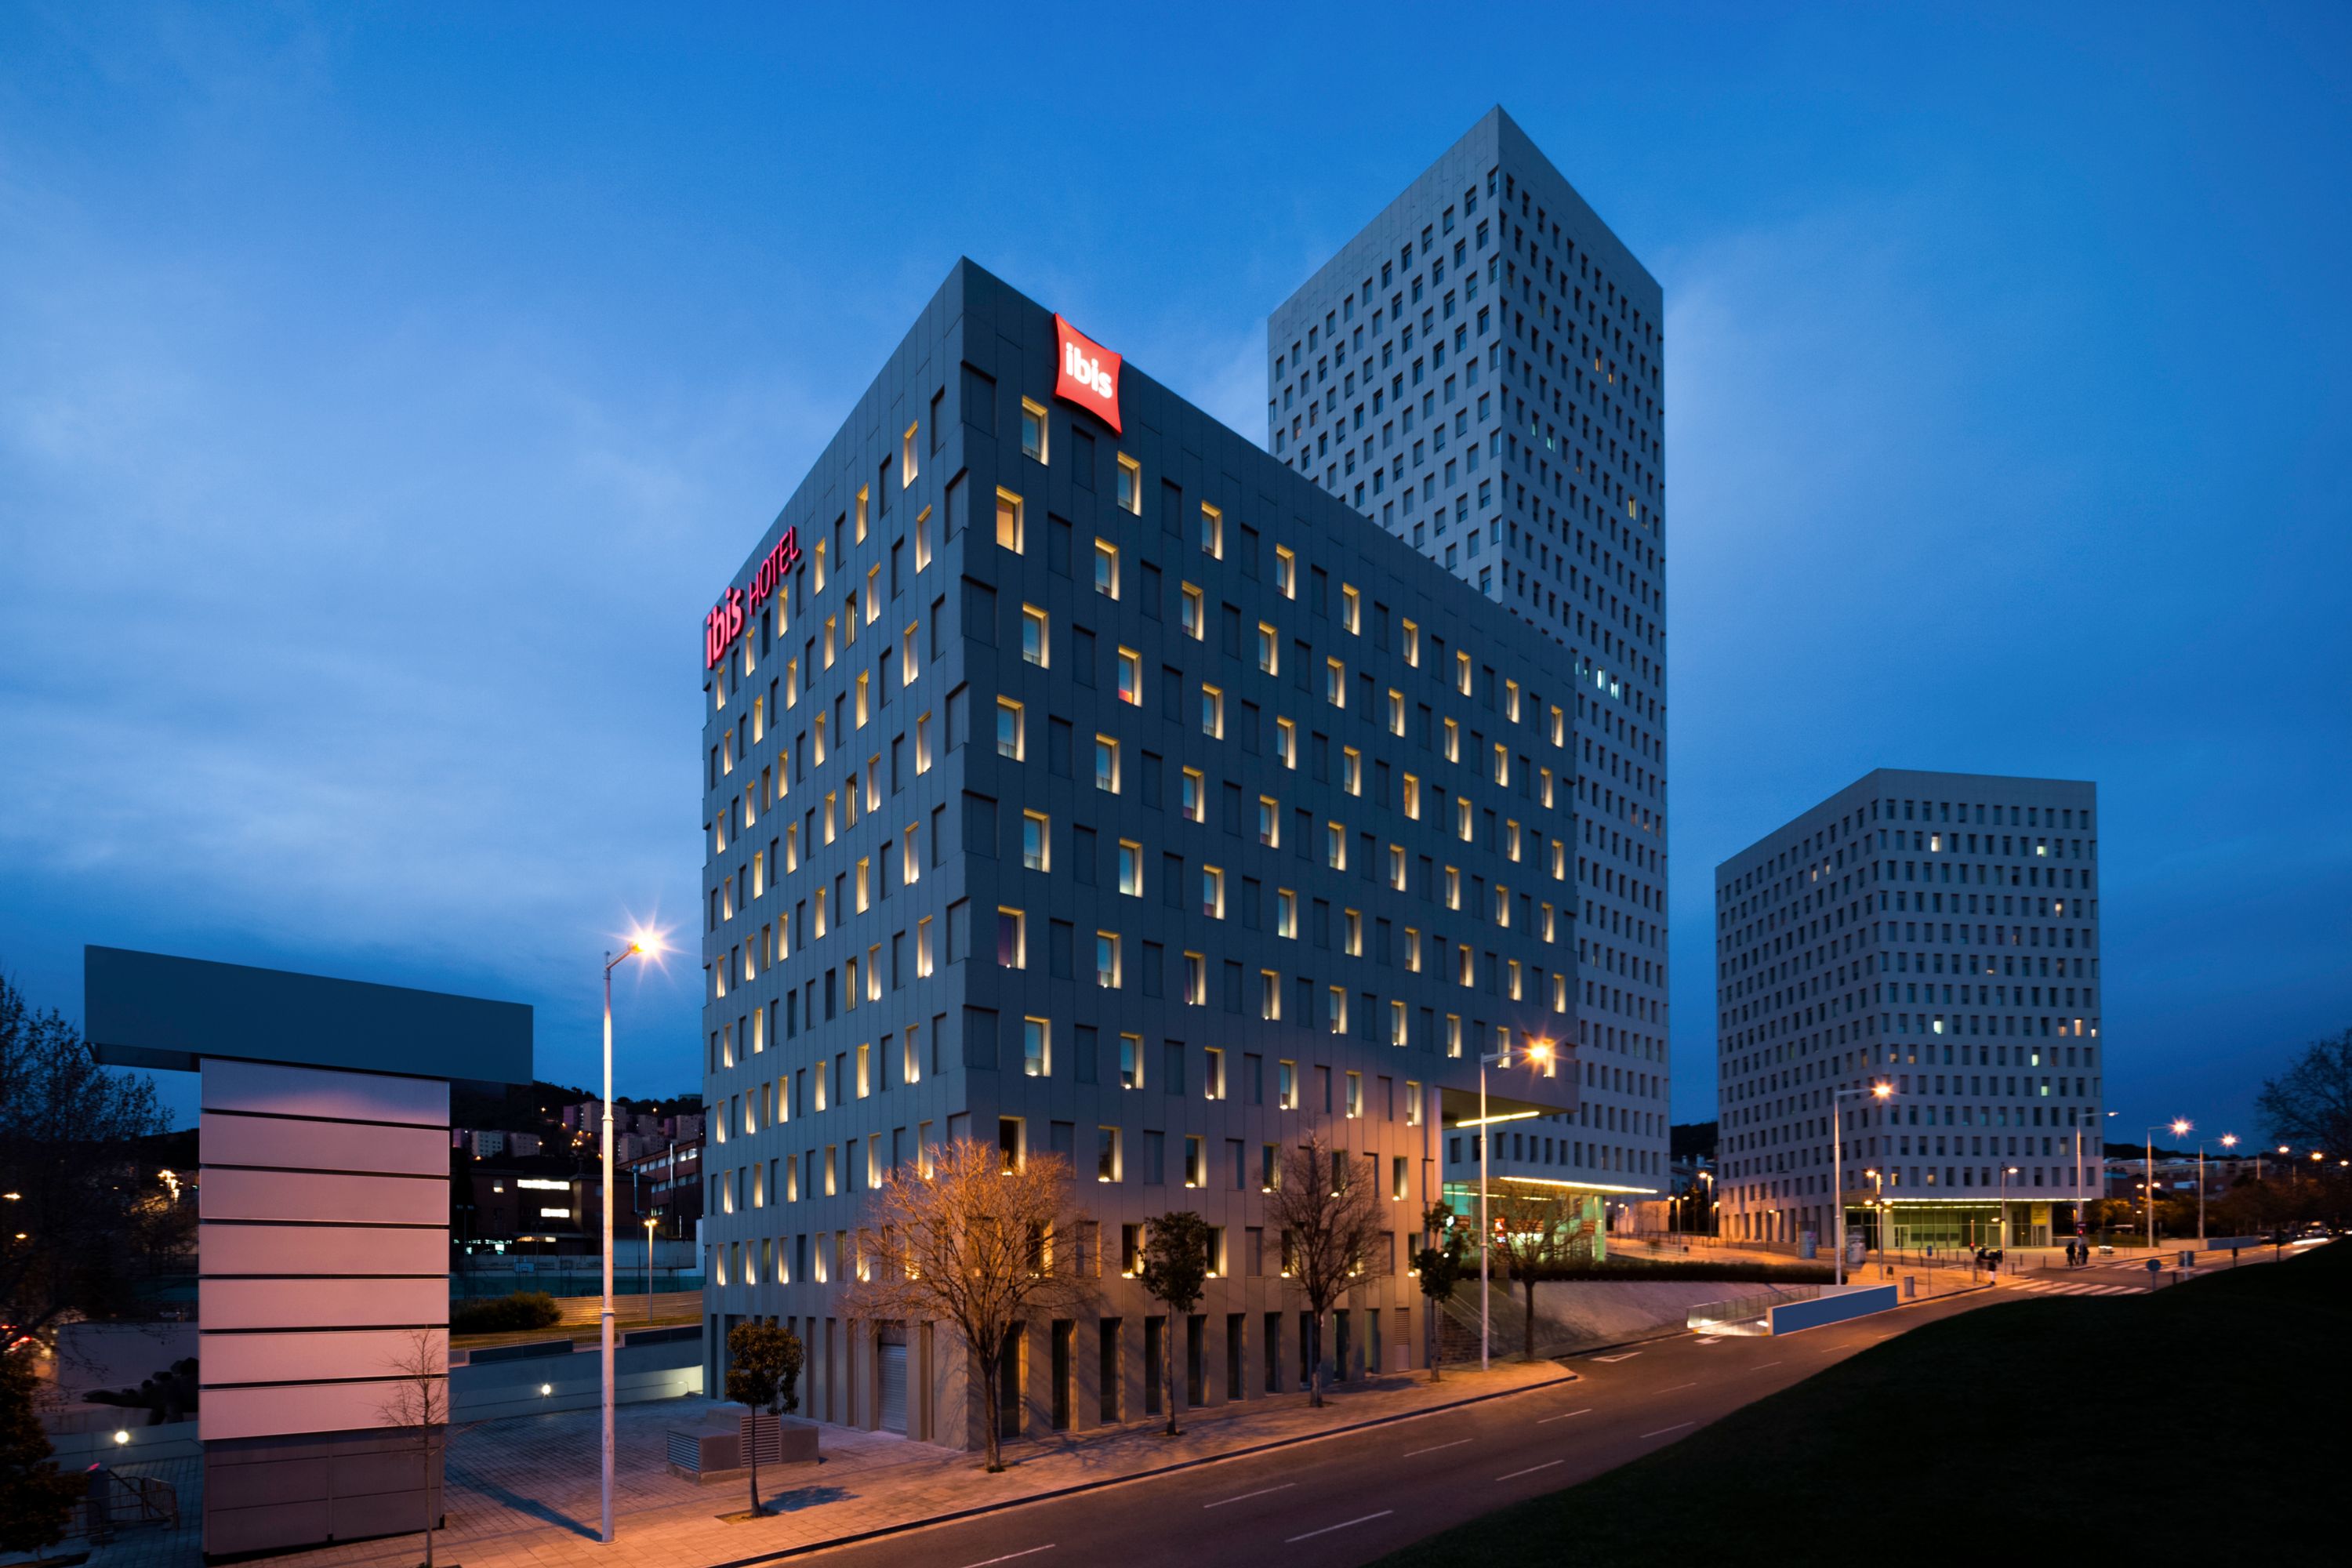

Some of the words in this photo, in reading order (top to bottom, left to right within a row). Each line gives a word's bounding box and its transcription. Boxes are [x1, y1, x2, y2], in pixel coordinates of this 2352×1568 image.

[1065, 341, 1112, 398] ibis
[706, 586, 744, 670] ibis
[749, 525, 800, 616] HOTEL
